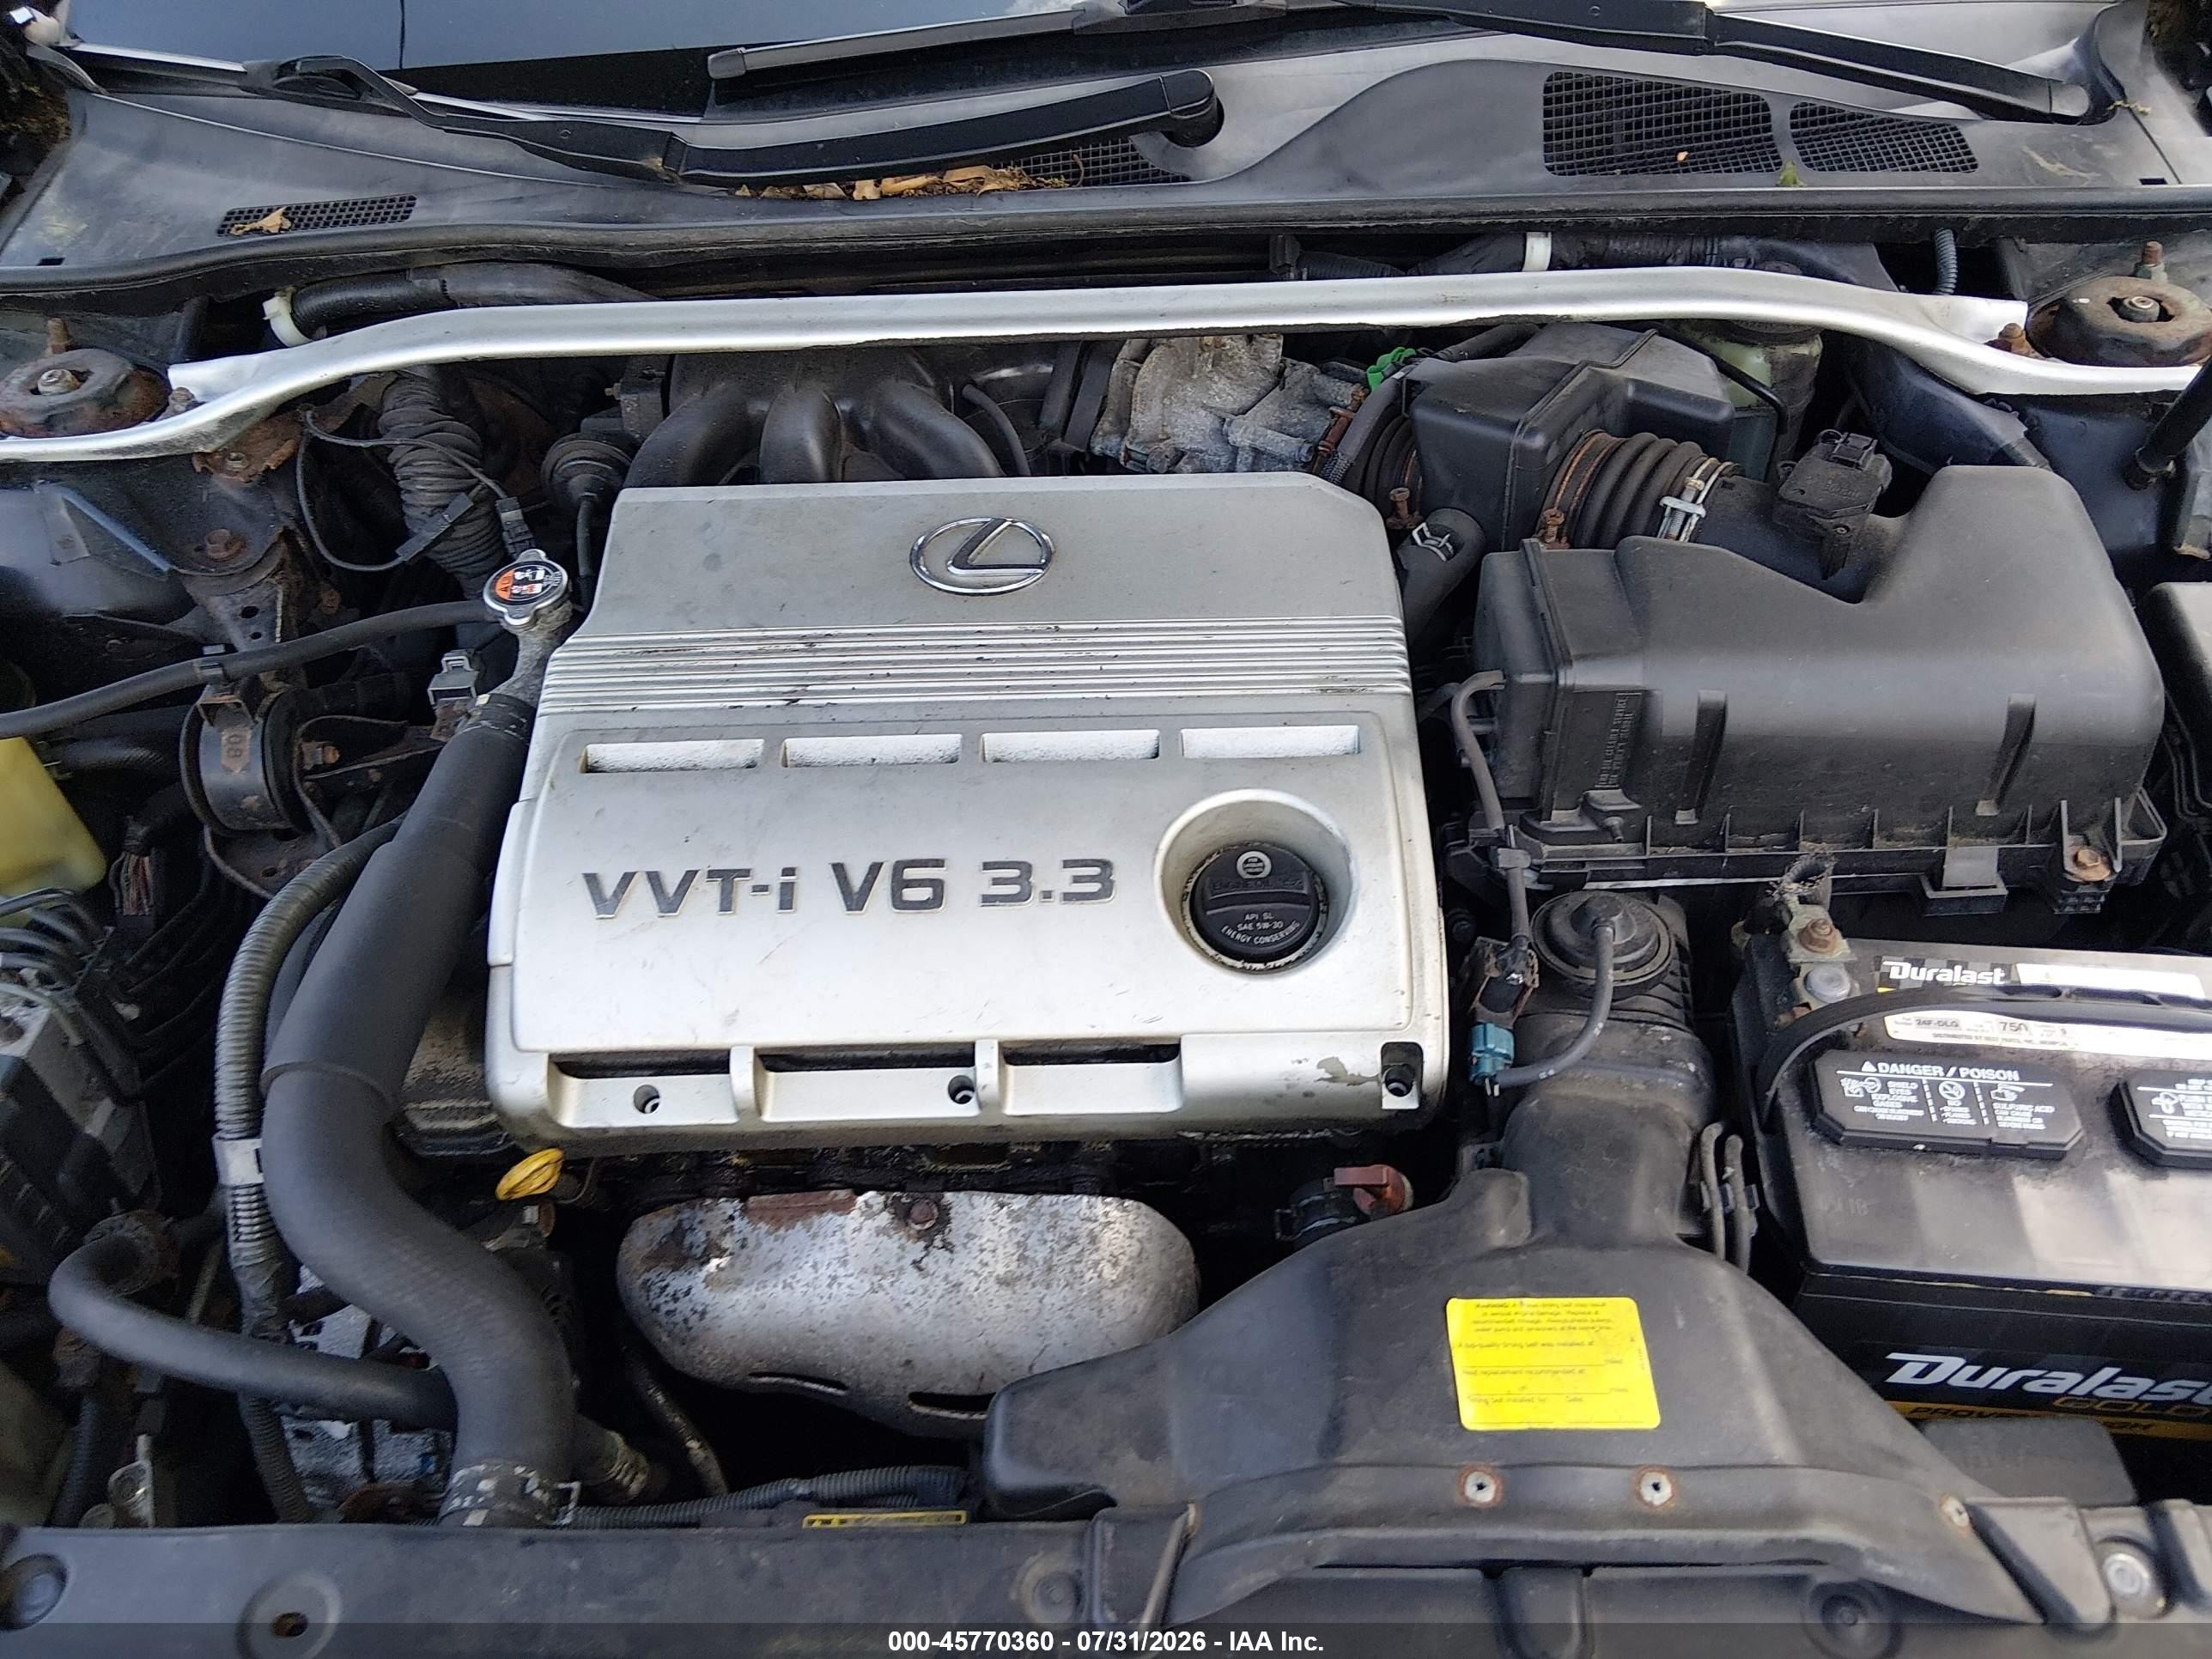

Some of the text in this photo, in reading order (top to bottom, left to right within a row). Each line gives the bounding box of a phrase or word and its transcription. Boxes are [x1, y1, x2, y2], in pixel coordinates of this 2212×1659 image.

[582, 859, 1117, 919] VVT-i V6 3.3
[1221, 921, 1300, 945] ENERGY CONSERVING
[1256, 921, 1284, 930] 5W-30
[1882, 960, 2007, 985] Duralast
[1877, 1061, 2021, 1081] DANGER / POISON
